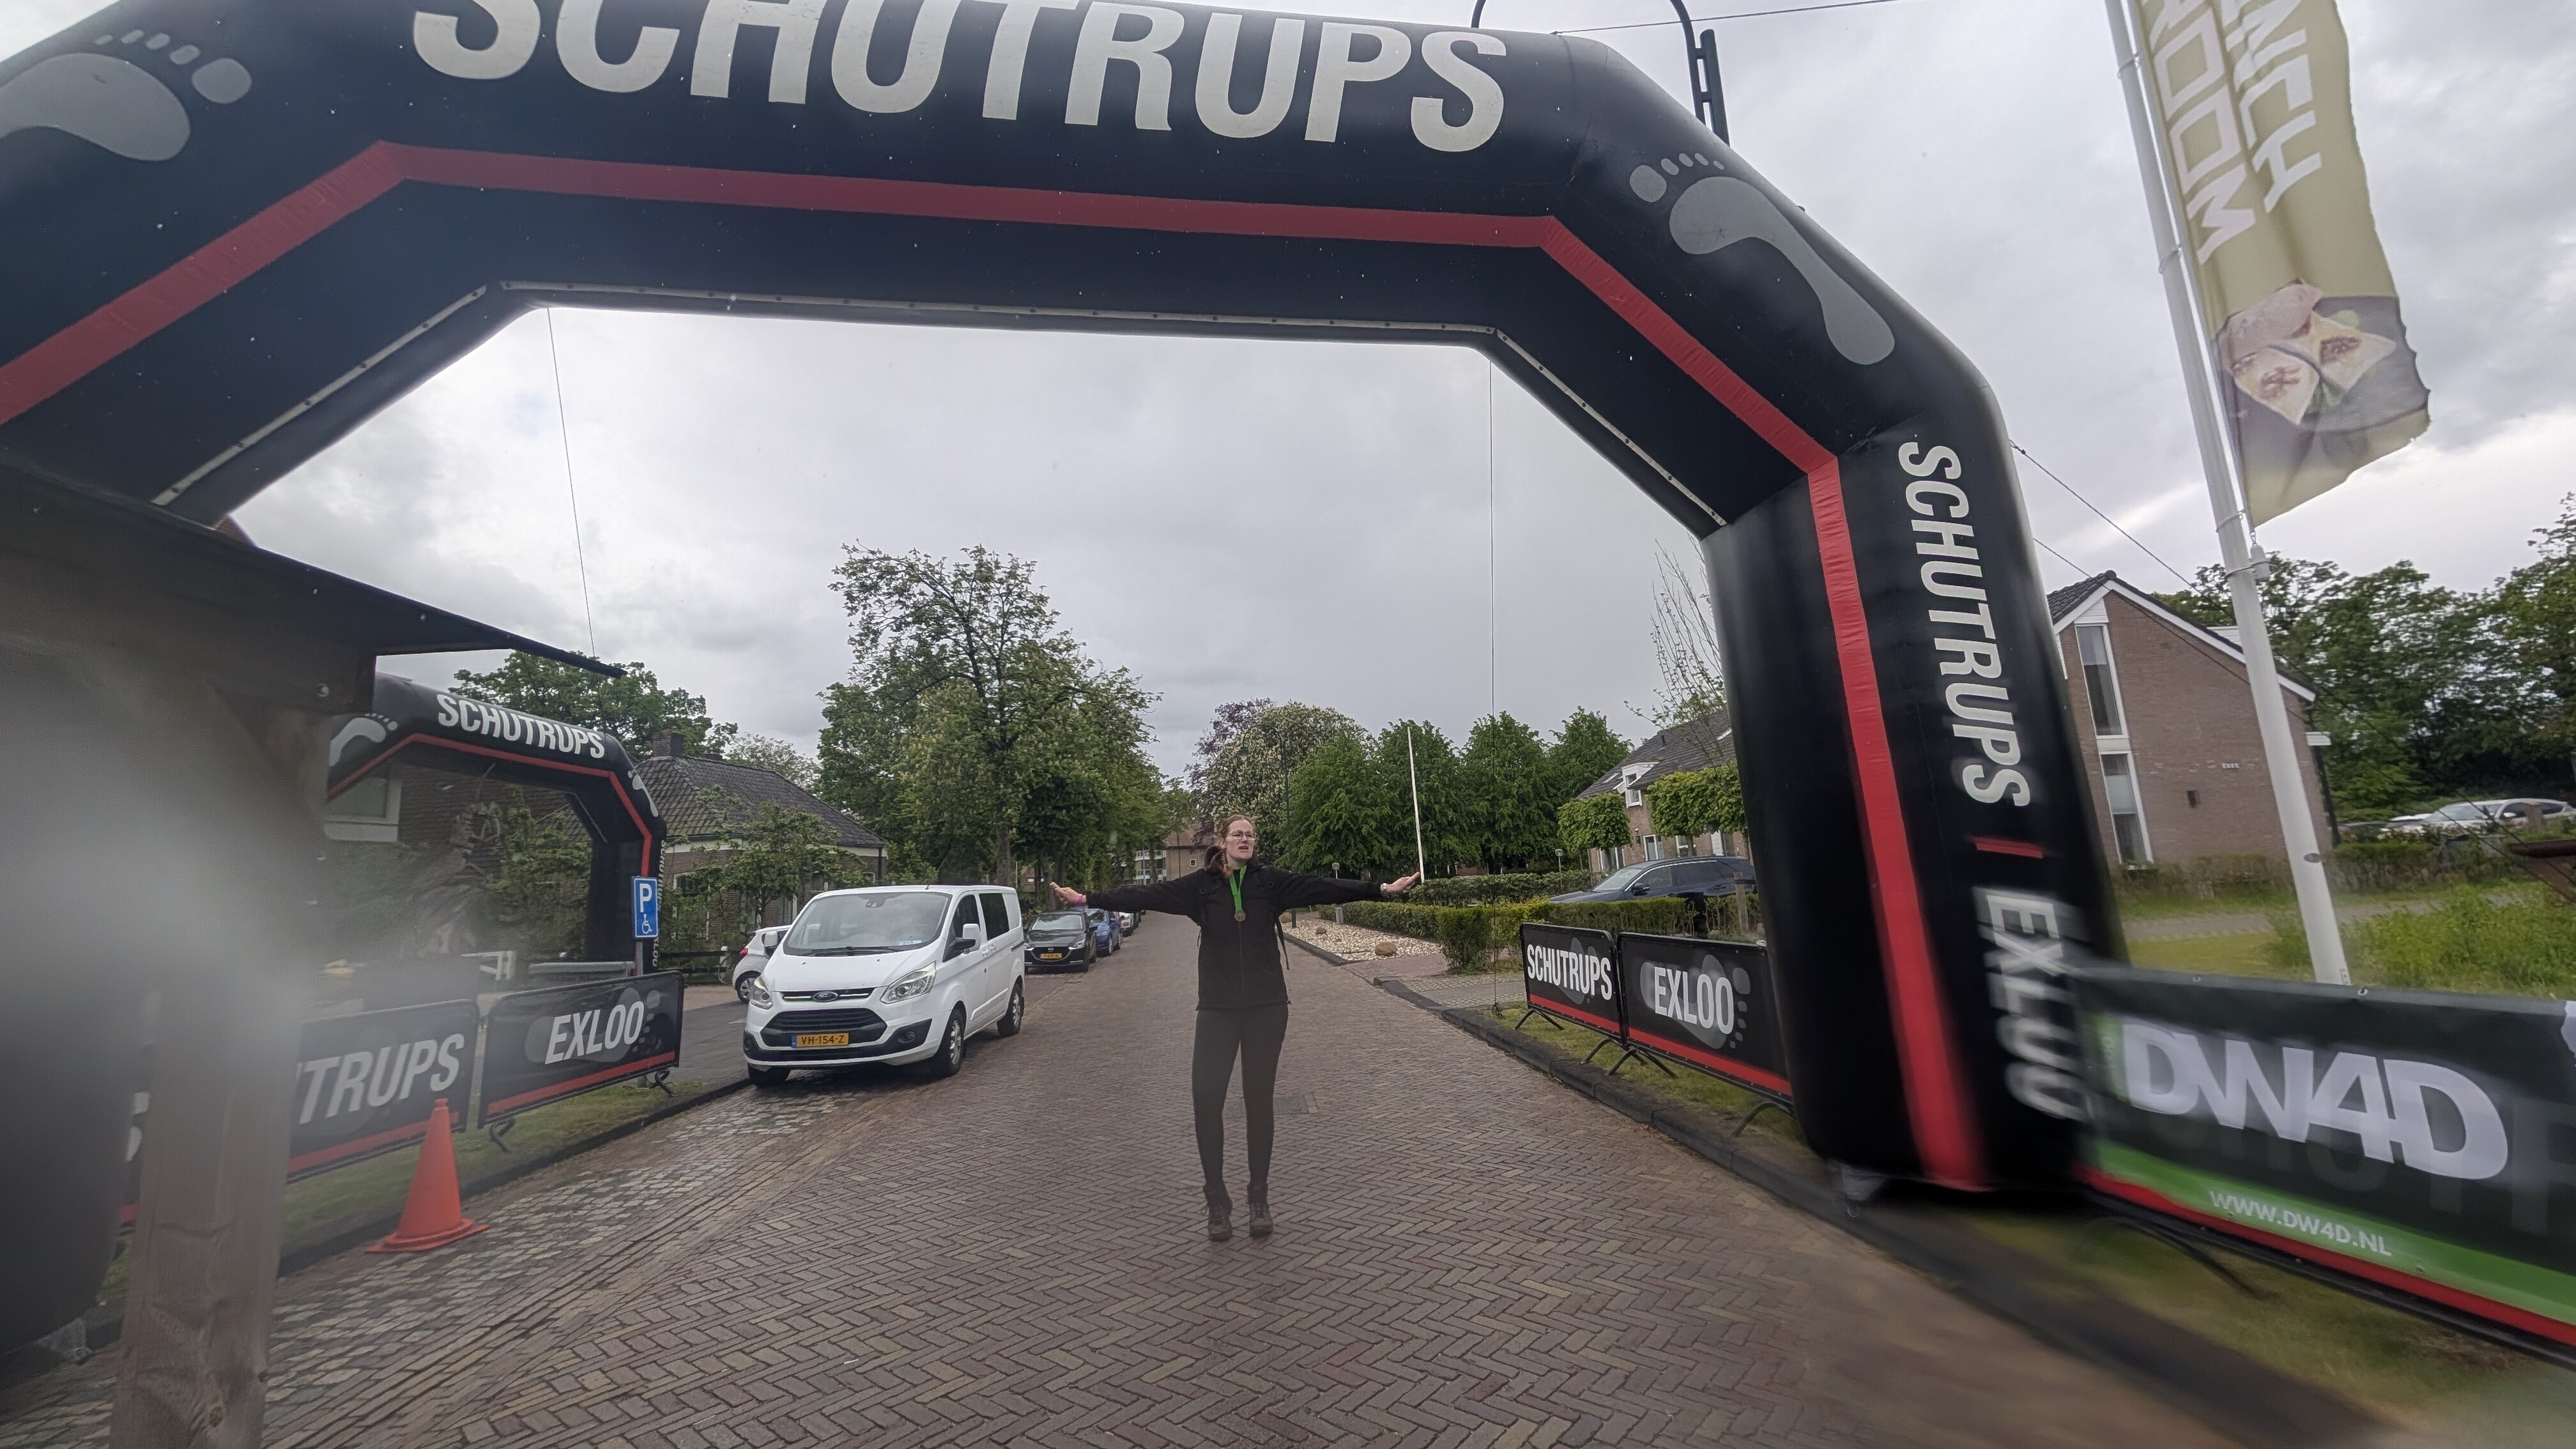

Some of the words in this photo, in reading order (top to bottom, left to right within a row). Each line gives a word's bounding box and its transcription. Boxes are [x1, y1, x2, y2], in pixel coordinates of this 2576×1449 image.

[413, 0, 1506, 153] SCHUTRUPS
[2221, 0, 2322, 213] NCH
[1898, 441, 2030, 807] SCHUTRUPS
[436, 693, 605, 759] SCHUTRUPS
[640, 883, 652, 913] P
[1526, 944, 1613, 1001] SCHUTRUPS
[1653, 966, 1735, 1035] EXLOO
[544, 1000, 645, 1065] EXLOO
[801, 1035, 845, 1045] VH-154-Z
[296, 1032, 466, 1124] TRUPS
[2121, 1020, 2509, 1181] DW4D
[2209, 1190, 2392, 1257] WWW.DW4D.NL
